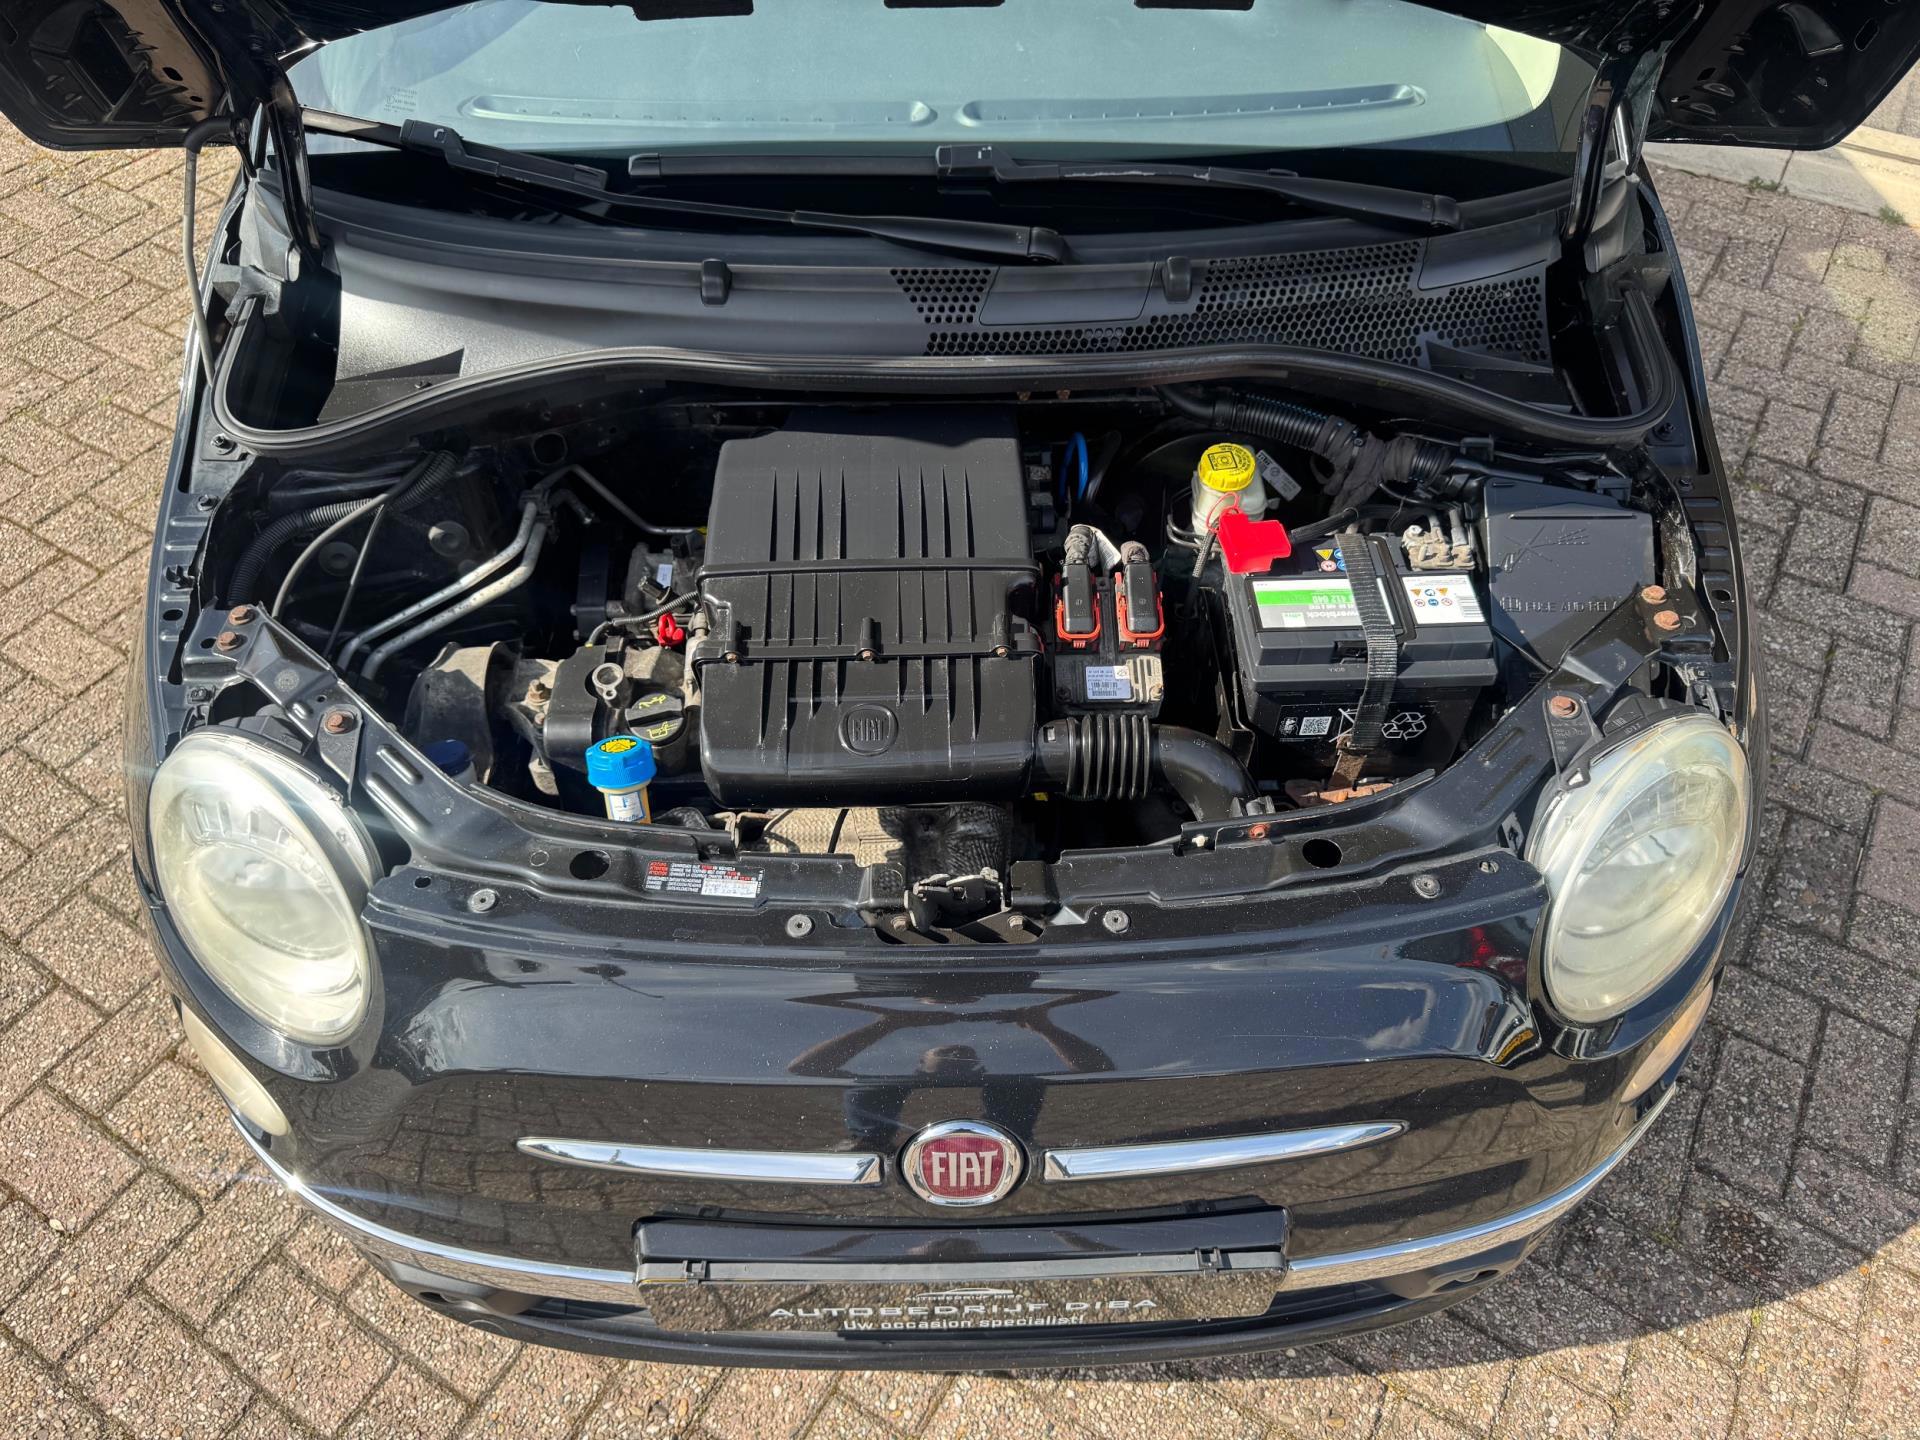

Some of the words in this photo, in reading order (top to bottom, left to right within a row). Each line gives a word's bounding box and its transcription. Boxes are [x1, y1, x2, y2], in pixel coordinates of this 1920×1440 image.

[1306, 610, 1359, 619] werblock
[852, 717, 885, 742] FIAT
[932, 1149, 998, 1187] FIAT
[769, 1303, 1049, 1317] AUTOBEDRIJF
[1065, 1300, 1157, 1311] DIBA
[843, 1320, 874, 1330] Uw
[880, 1318, 971, 1330] occasion
[979, 1315, 1084, 1328] specialist!
